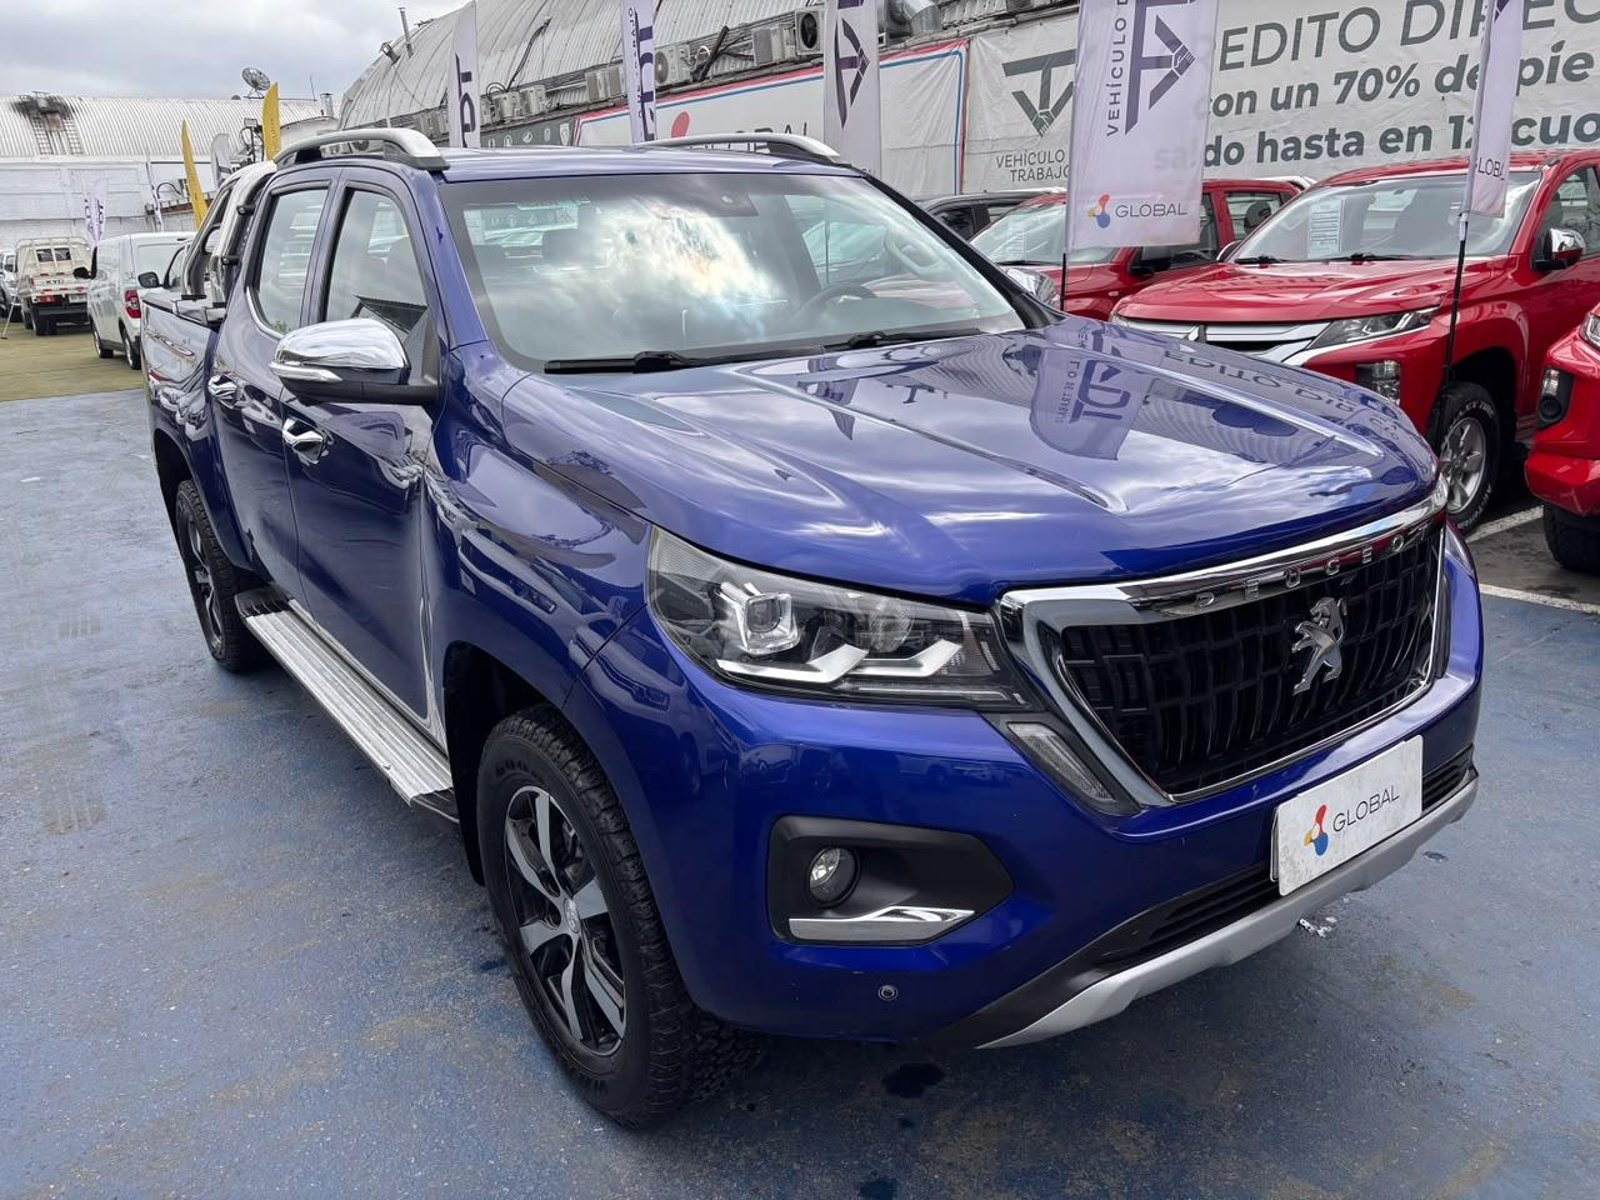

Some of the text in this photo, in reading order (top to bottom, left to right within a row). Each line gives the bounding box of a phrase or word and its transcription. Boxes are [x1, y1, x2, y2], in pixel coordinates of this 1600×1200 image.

[1270, 81, 1319, 111] un
[1333, 62, 1420, 104] 70%
[1256, 128, 1365, 163] hasta
[1379, 123, 1432, 154] en
[1115, 203, 1188, 218] GLOBAL
[1196, 523, 1430, 607] PEUGEOT
[1332, 785, 1400, 832] GLOBAL
